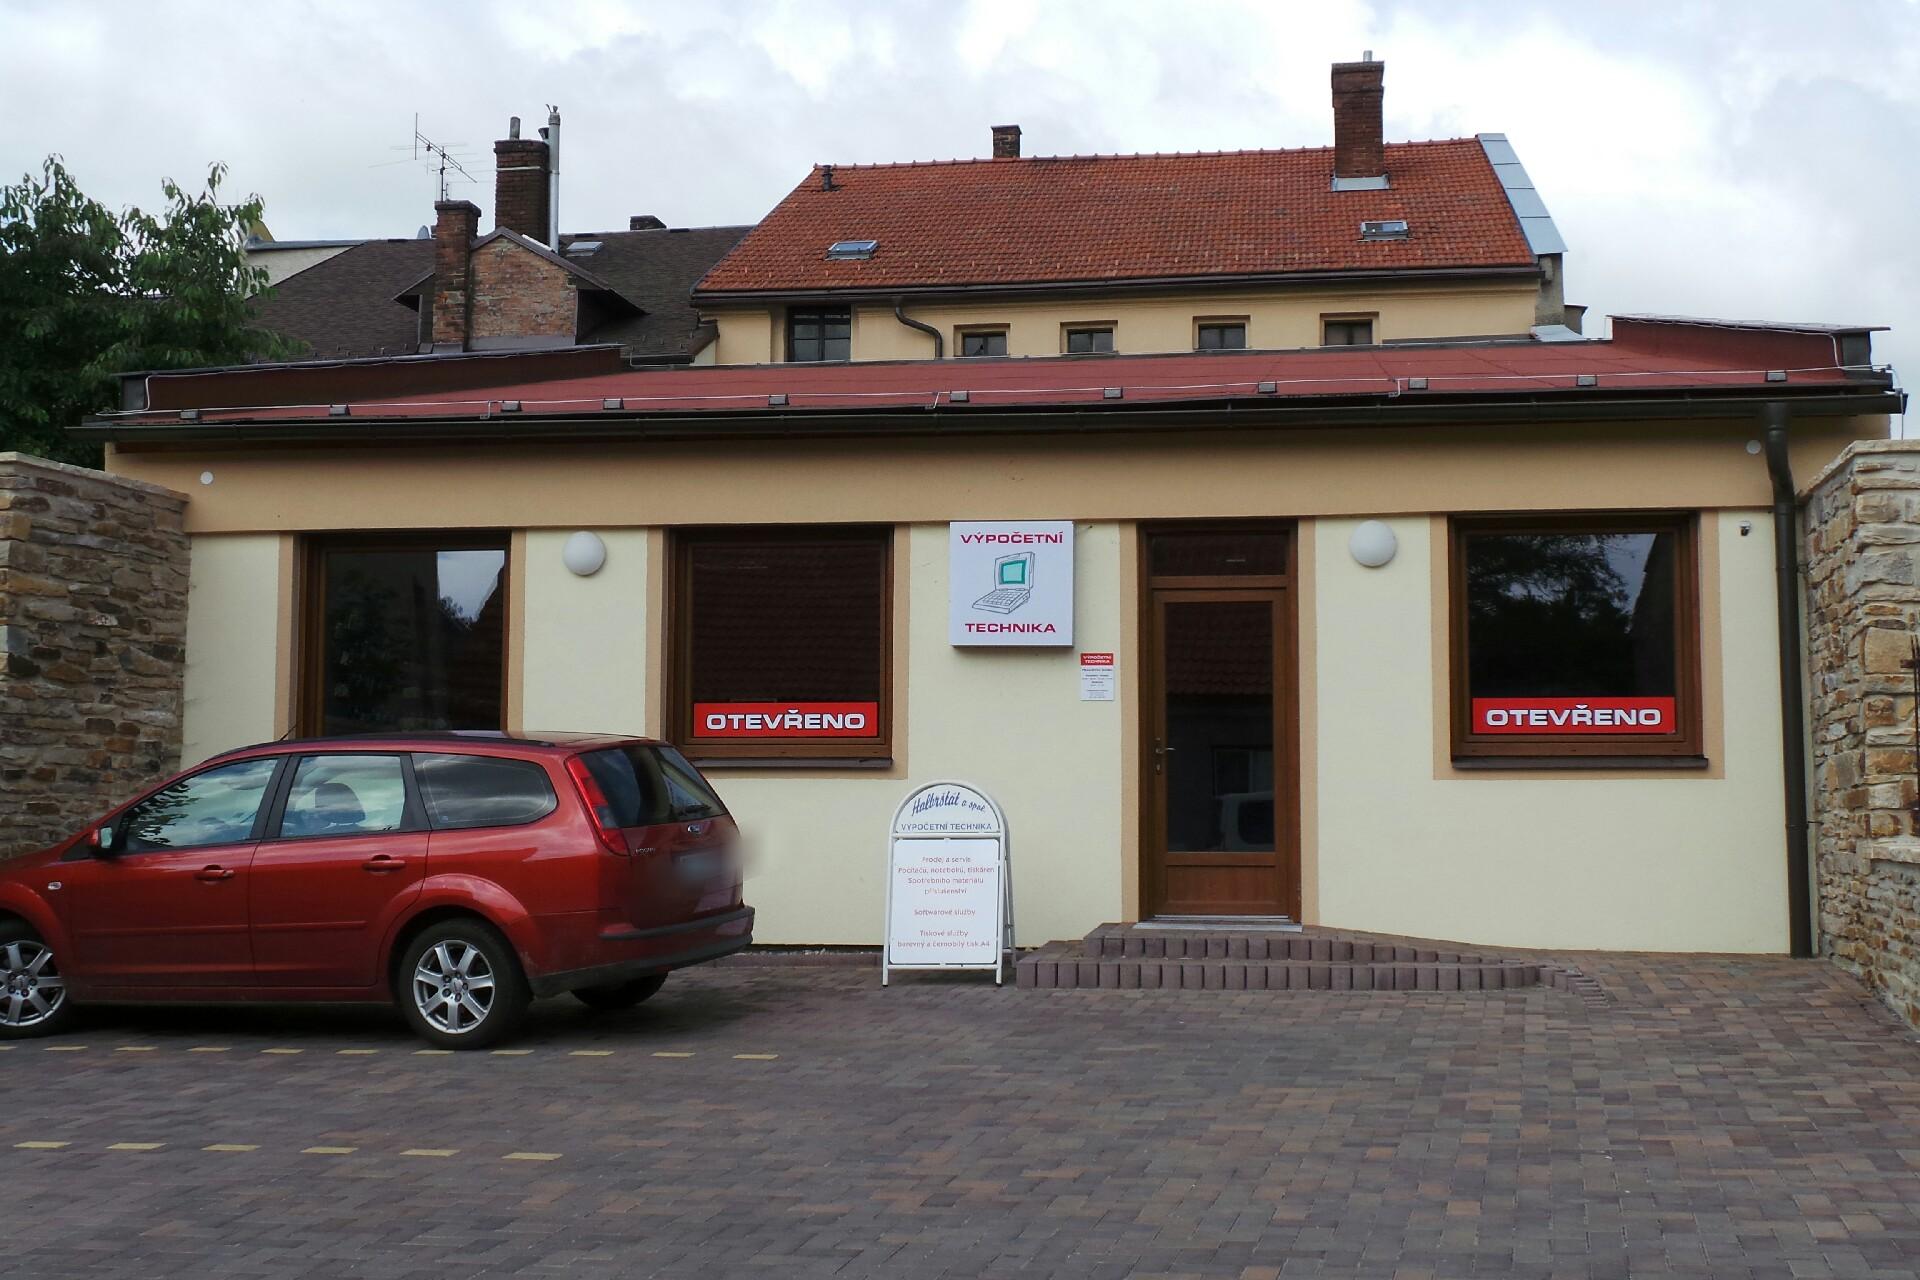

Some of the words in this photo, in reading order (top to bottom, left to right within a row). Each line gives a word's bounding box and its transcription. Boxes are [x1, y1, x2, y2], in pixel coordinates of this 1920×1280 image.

[960, 531, 1064, 544] VÝPOČETNÍ
[965, 623, 1056, 633] TECHNIKA
[705, 709, 866, 730] OTEVŘENO
[1485, 704, 1662, 727] OTEVŘENO
[961, 799, 967, 807] a
[901, 822, 948, 831] VÝPOČETNÍ
